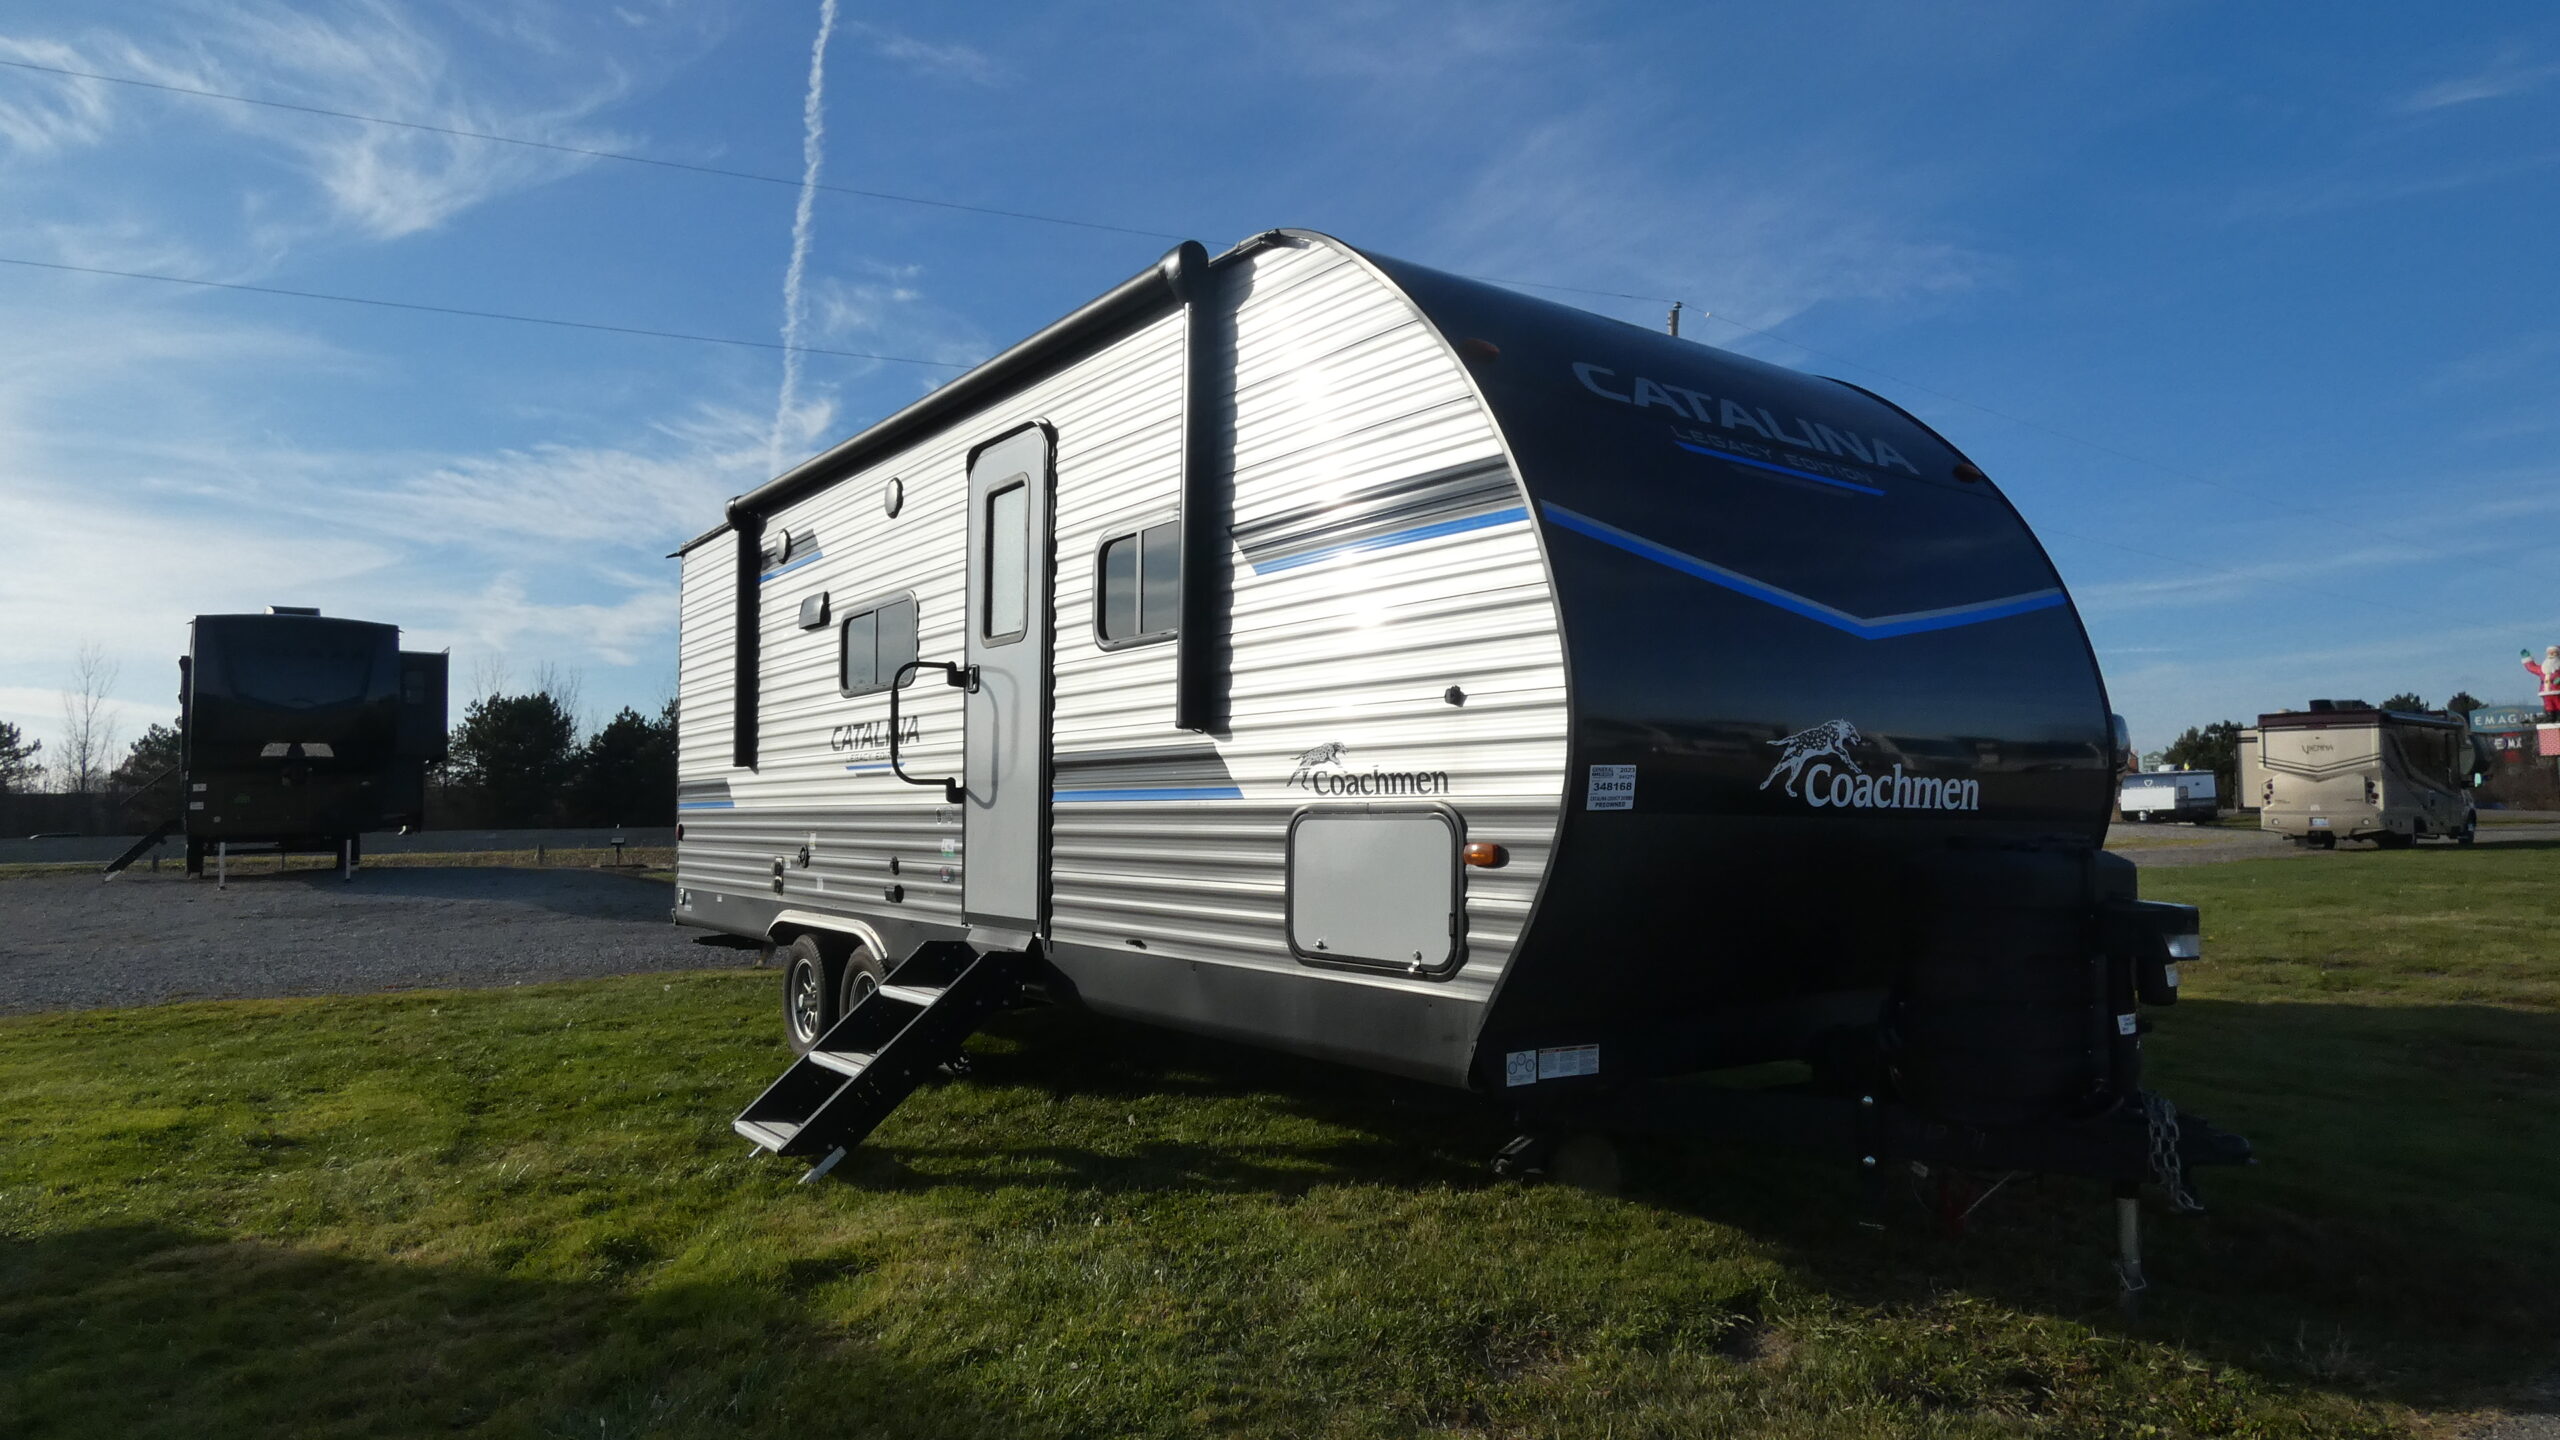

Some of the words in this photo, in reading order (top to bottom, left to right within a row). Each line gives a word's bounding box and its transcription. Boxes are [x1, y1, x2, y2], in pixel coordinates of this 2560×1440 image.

[1571, 361, 1920, 476] CATALINA
[1670, 424, 1773, 460] LEGACY
[1782, 452, 1874, 484] EDITION
[2474, 712, 2545, 726] EMAGN
[1312, 764, 1450, 796] Coachmen
[1593, 782, 1632, 791] 348168
[1805, 763, 1979, 811] Coachmen
